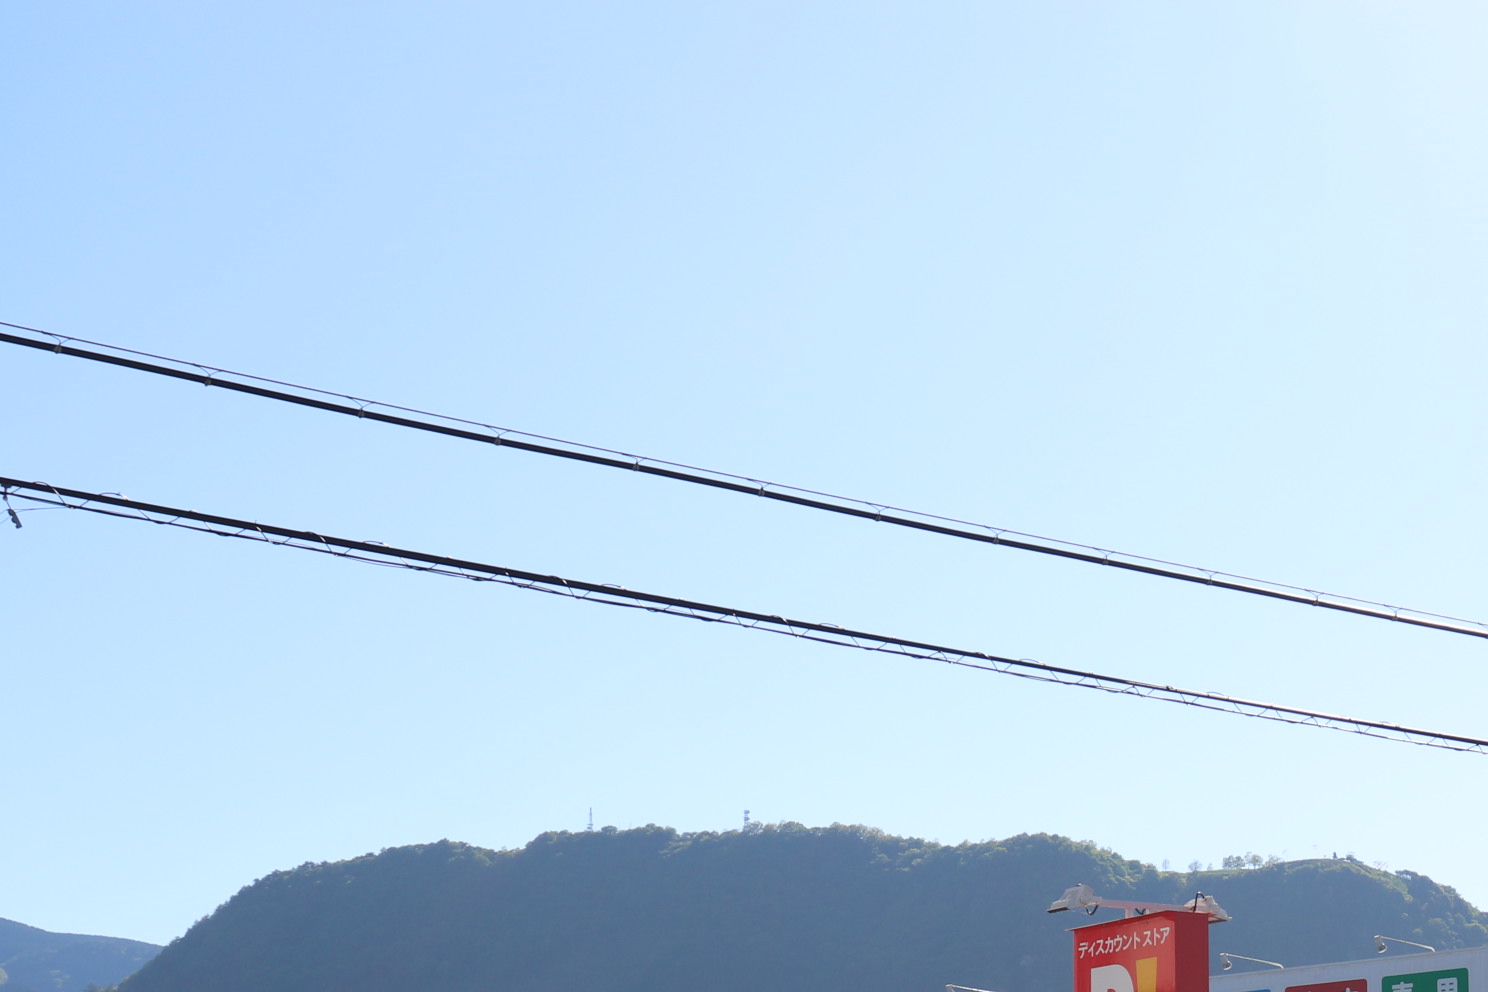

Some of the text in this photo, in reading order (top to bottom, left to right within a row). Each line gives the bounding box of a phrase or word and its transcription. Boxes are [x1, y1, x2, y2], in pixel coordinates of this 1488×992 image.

[1078, 926, 1171, 959] ディスカウント ストア
